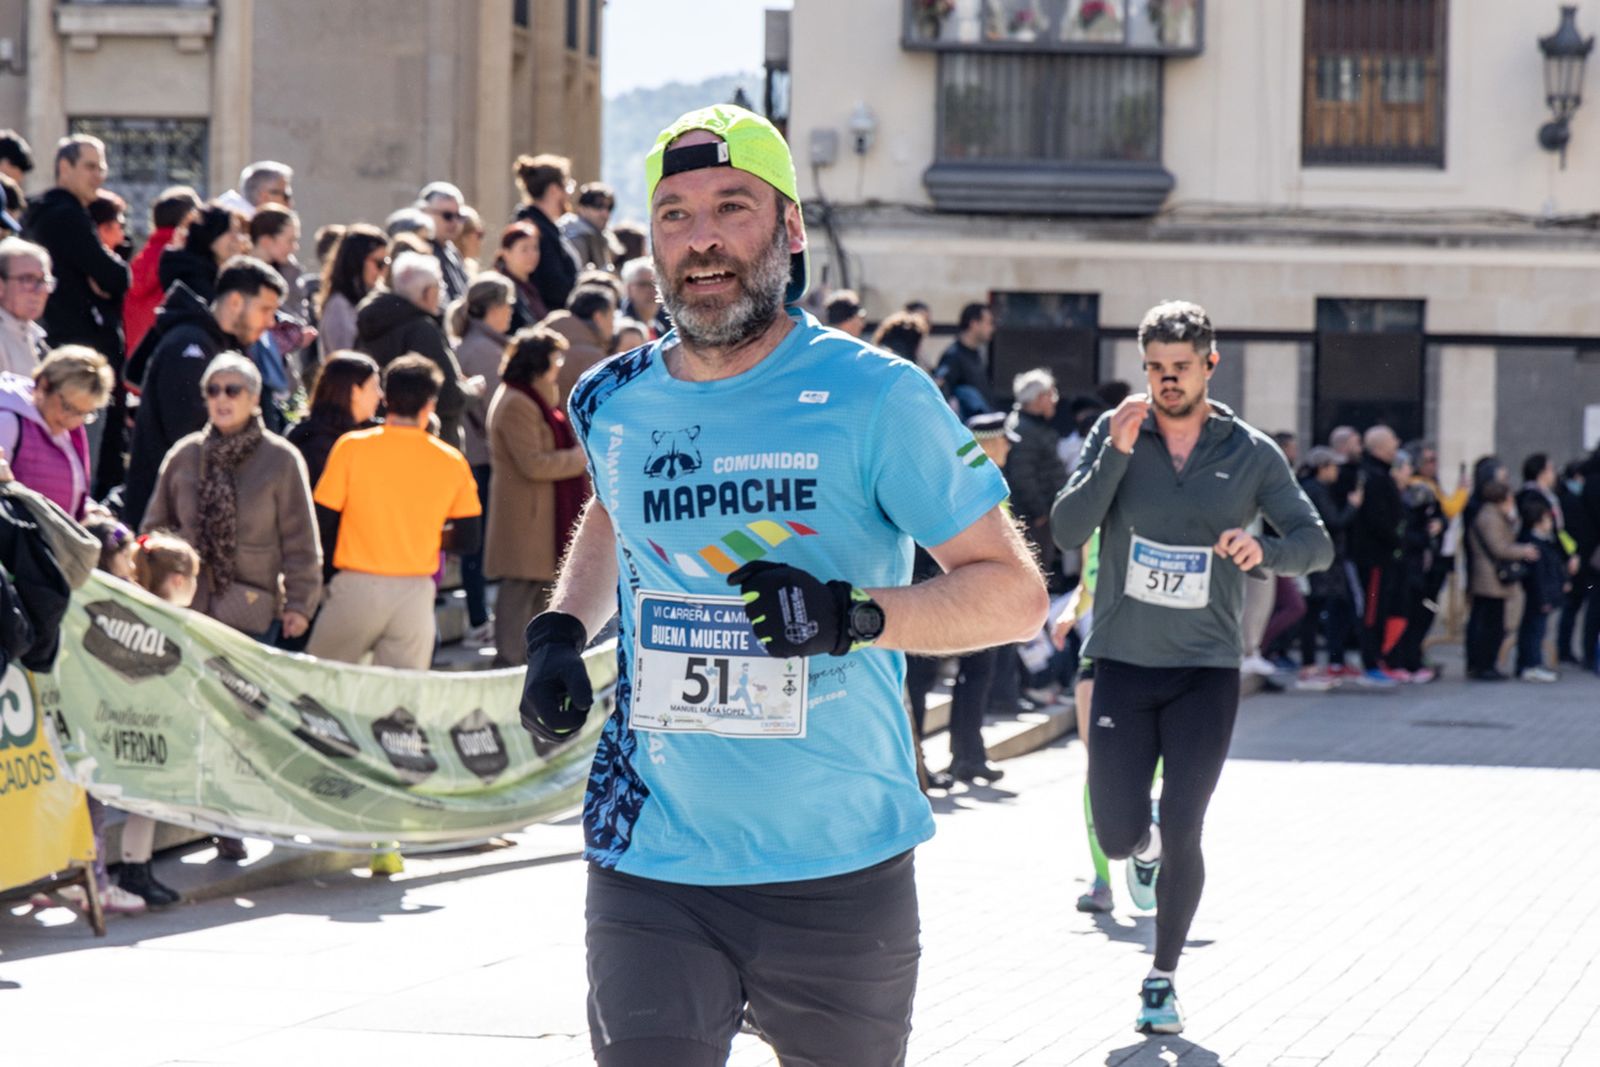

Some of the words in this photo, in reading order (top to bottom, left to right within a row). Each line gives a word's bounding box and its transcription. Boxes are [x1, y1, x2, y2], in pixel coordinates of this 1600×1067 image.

[713, 453, 819, 474] COMUNIDAD
[643, 478, 818, 524] MAPACHE
[1145, 570, 1186, 593] 517
[652, 606, 662, 618] VI
[663, 607, 712, 622] CARRERA
[651, 624, 687, 647] BUENA
[690, 628, 750, 651] MUERTE
[682, 656, 730, 705] 51
[670, 704, 698, 713] MANUEL
[700, 706, 722, 714] MATA
[113, 729, 169, 766] VERDAD
